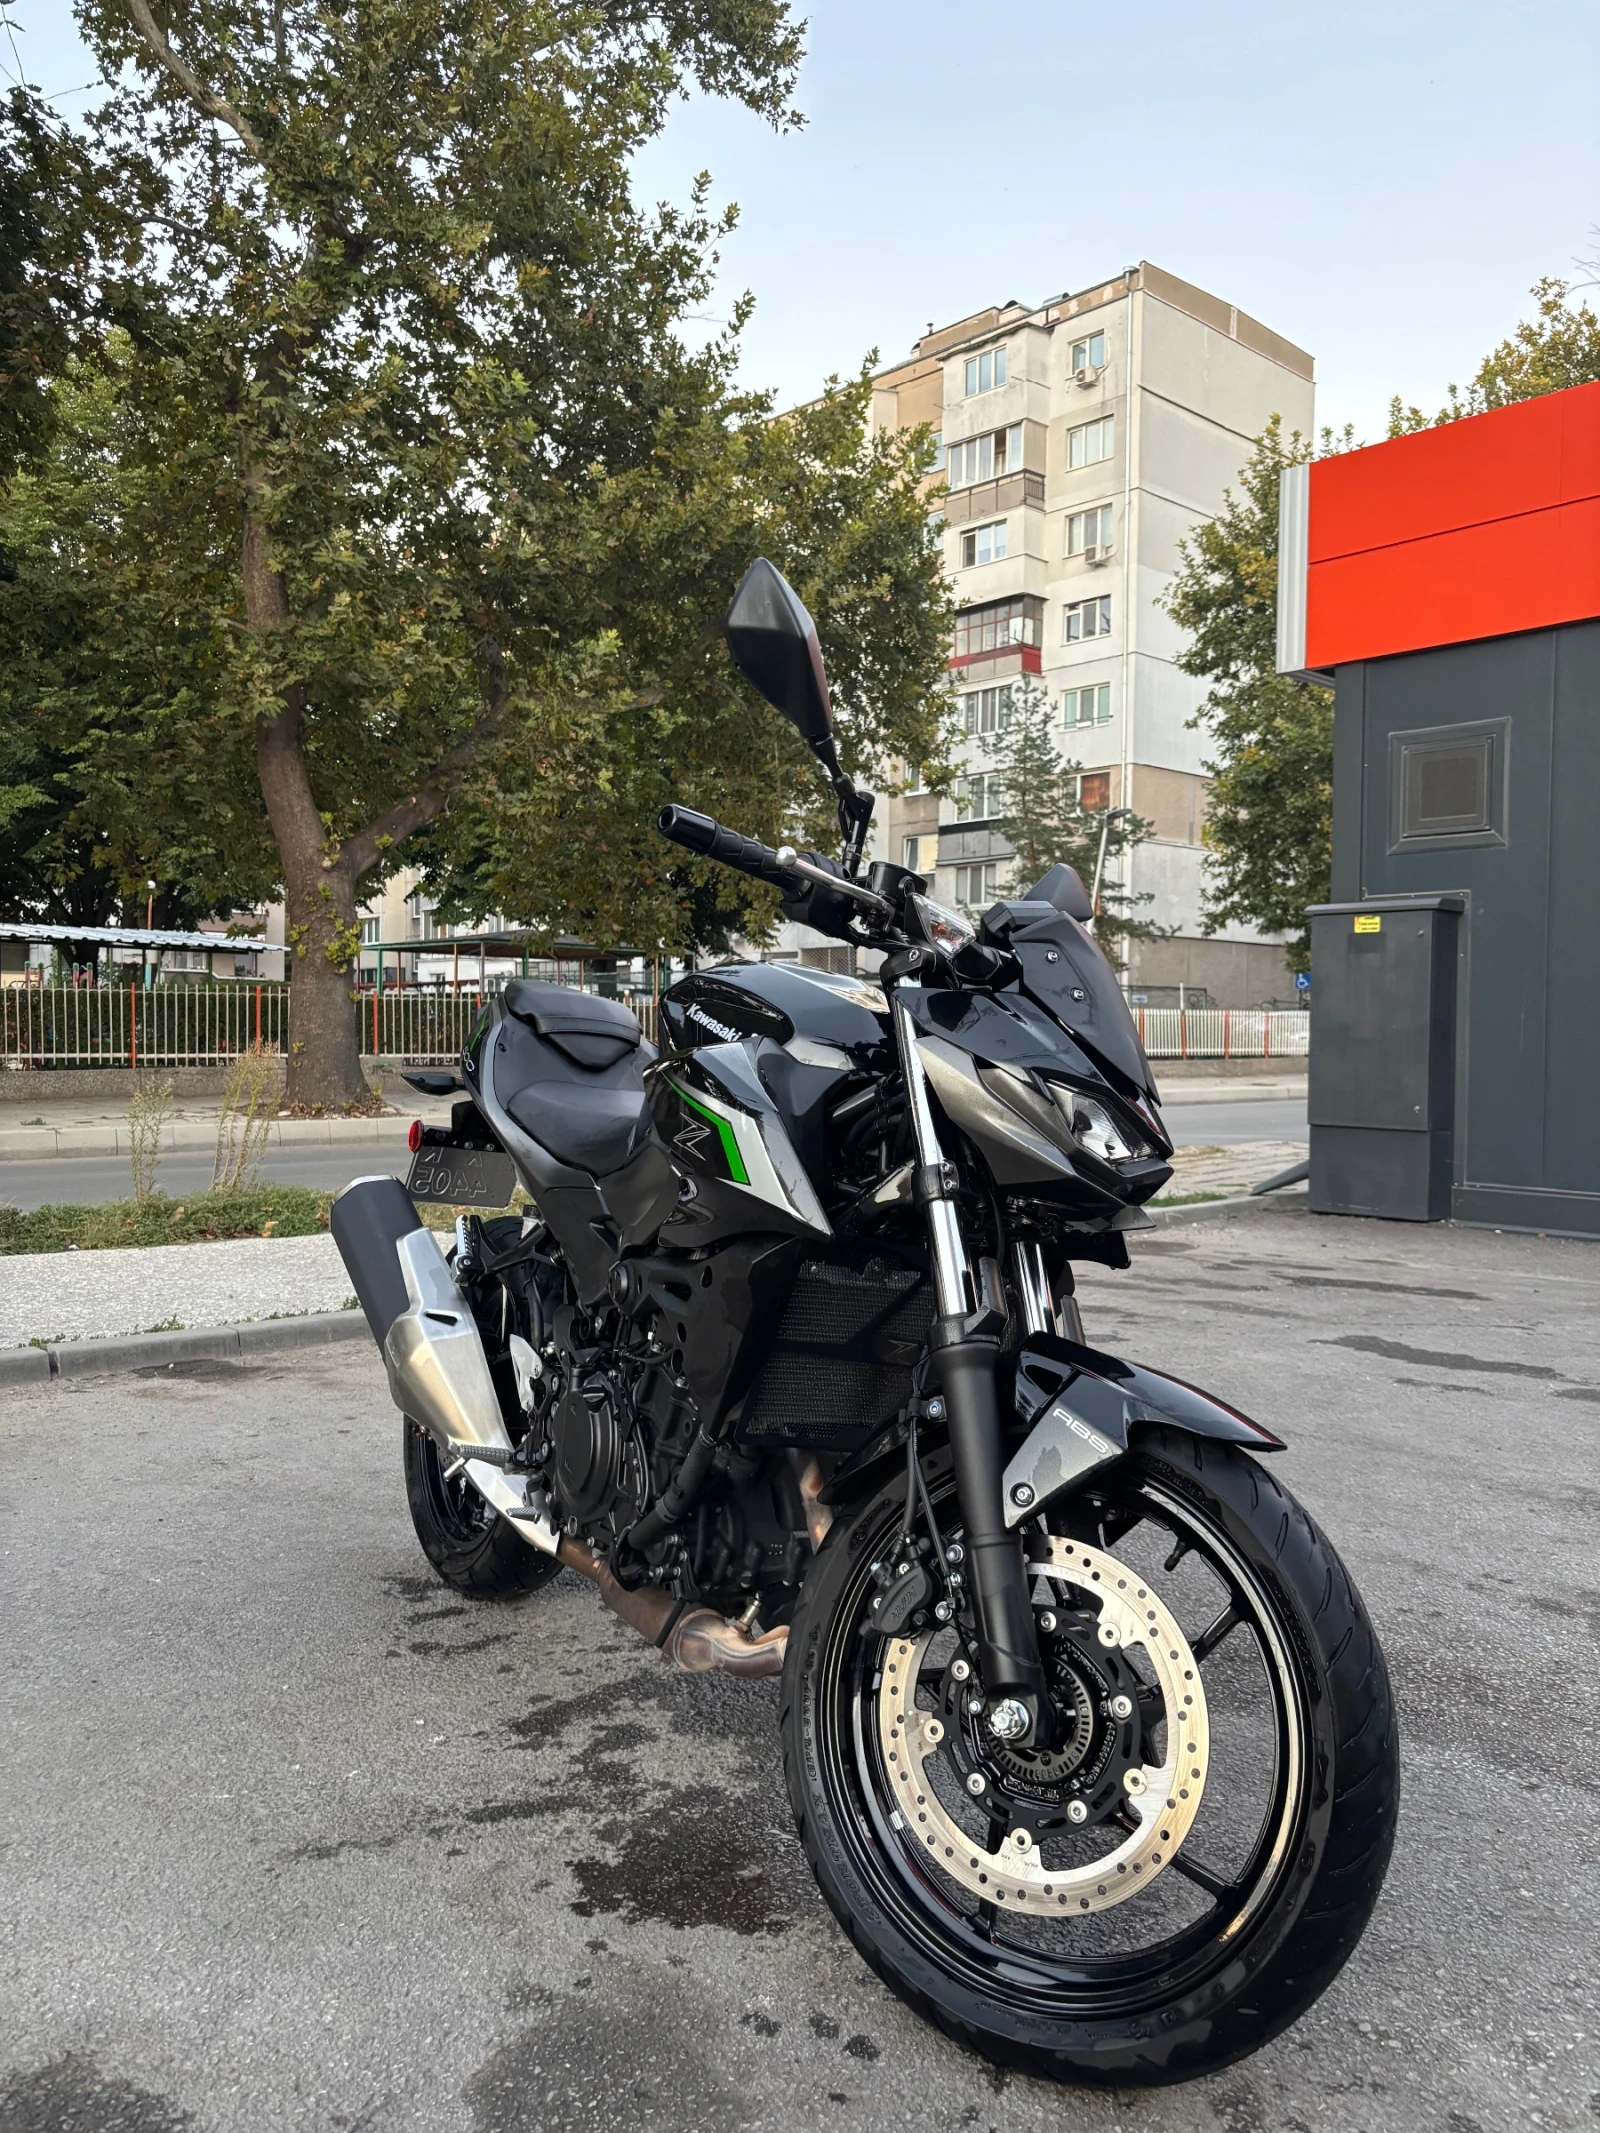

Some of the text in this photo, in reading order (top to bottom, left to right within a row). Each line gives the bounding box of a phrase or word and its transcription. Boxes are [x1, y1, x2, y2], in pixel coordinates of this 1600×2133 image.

[686, 1003, 742, 1042] Kawasaki
[1052, 1408, 1109, 1454] ABS
[812, 1793, 879, 1923] SPORTMAX
